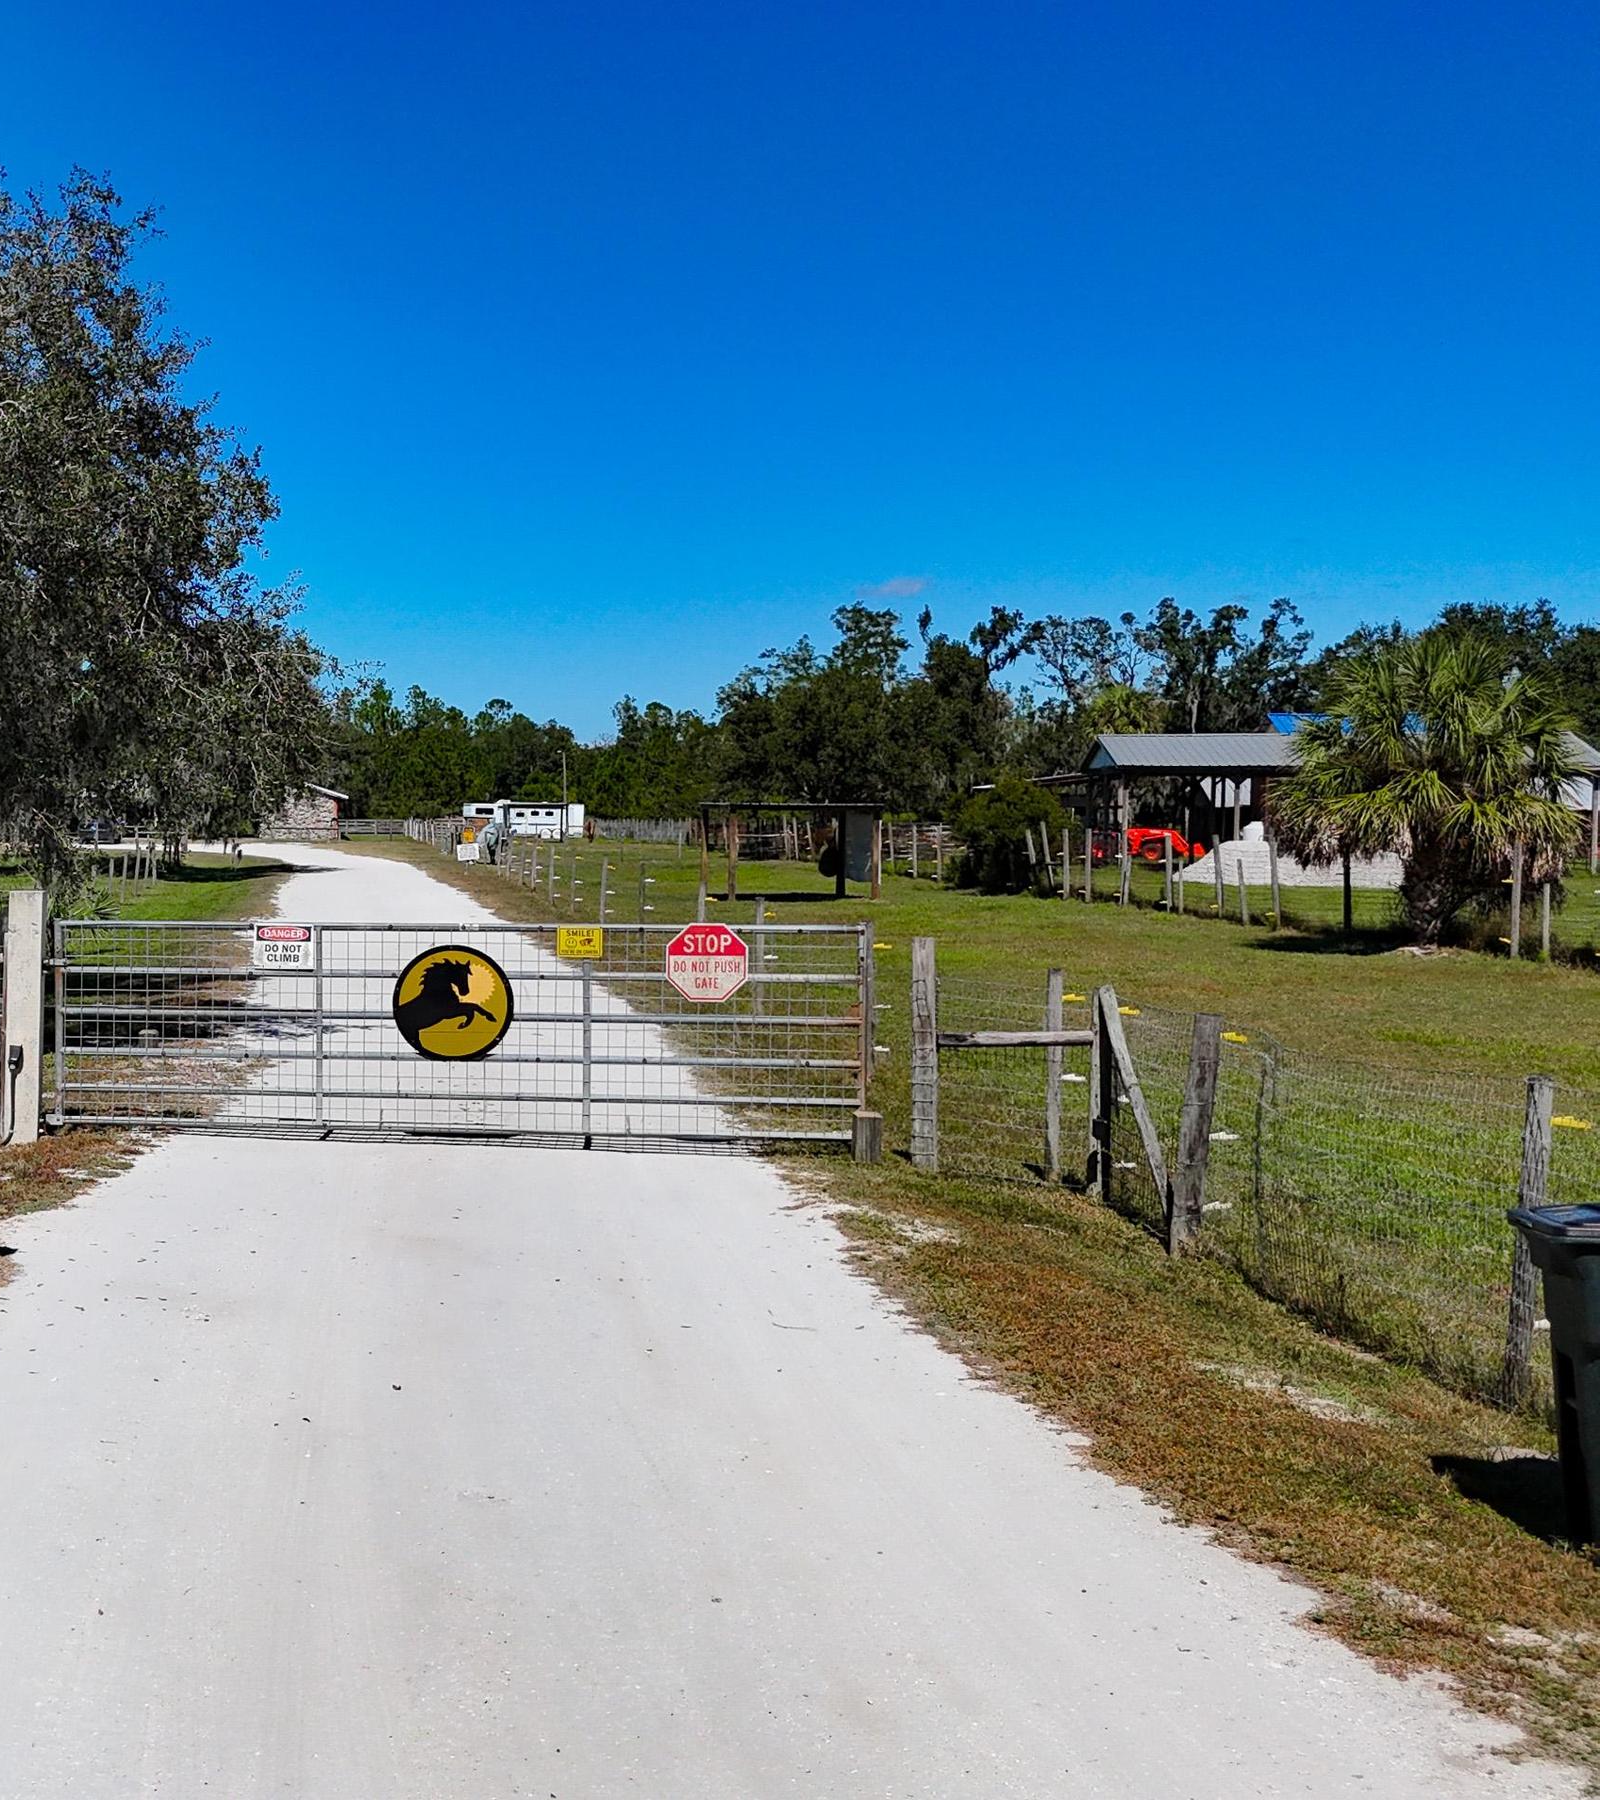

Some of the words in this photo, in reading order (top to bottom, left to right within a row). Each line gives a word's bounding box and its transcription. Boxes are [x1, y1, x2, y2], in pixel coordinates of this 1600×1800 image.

[264, 929, 304, 938] DANGER
[566, 929, 595, 937] SMILE!
[264, 944, 279, 953] DO
[281, 944, 302, 953] NOT
[682, 933, 732, 954] STOP
[266, 953, 300, 963] CLIMB
[673, 960, 687, 973] DO
[691, 960, 709, 973] NOT
[714, 961, 740, 973] PUSH
[695, 977, 719, 989] GATE
